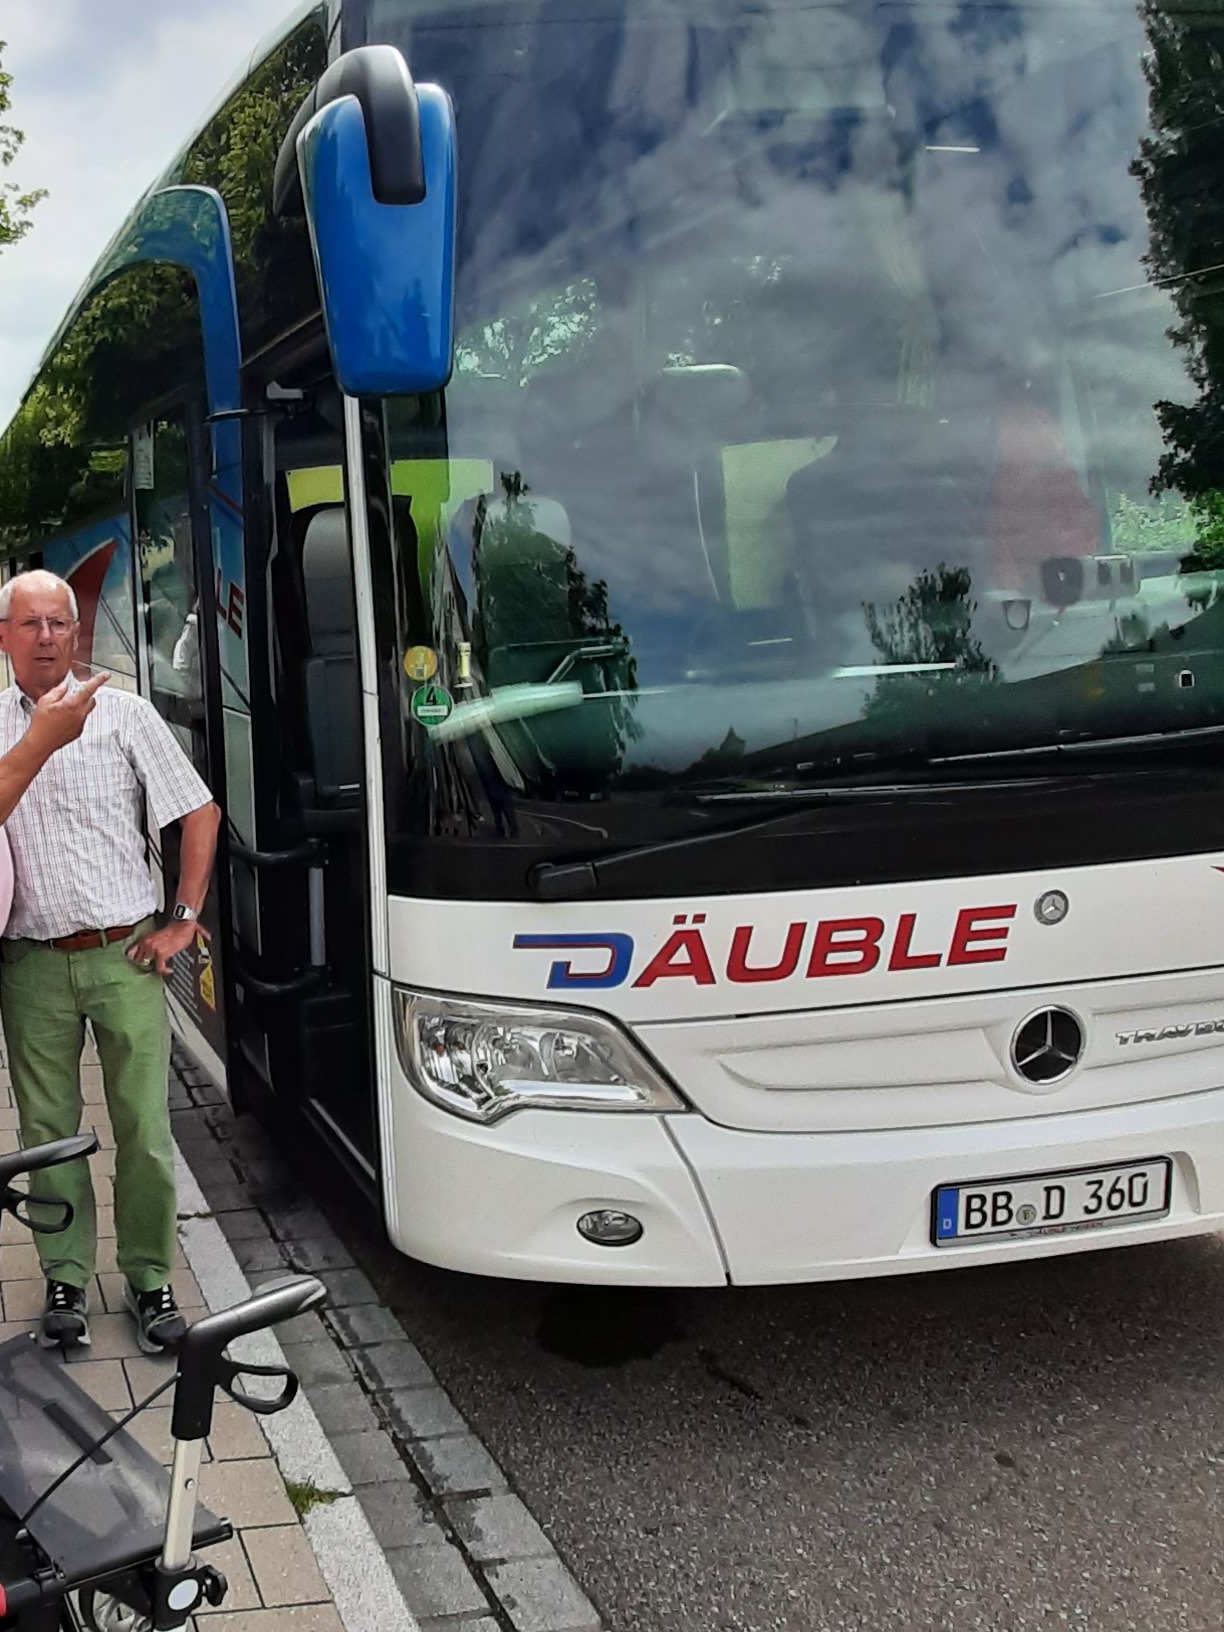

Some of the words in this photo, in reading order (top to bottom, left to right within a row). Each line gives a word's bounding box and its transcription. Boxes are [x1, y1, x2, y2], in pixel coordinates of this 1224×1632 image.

[425, 686, 438, 705] 4
[512, 903, 1018, 990] DÄUBLE
[964, 1191, 1014, 1230] BB
[1041, 1184, 1066, 1221] D
[1083, 1171, 1149, 1215] 360
[942, 1218, 952, 1231] D
